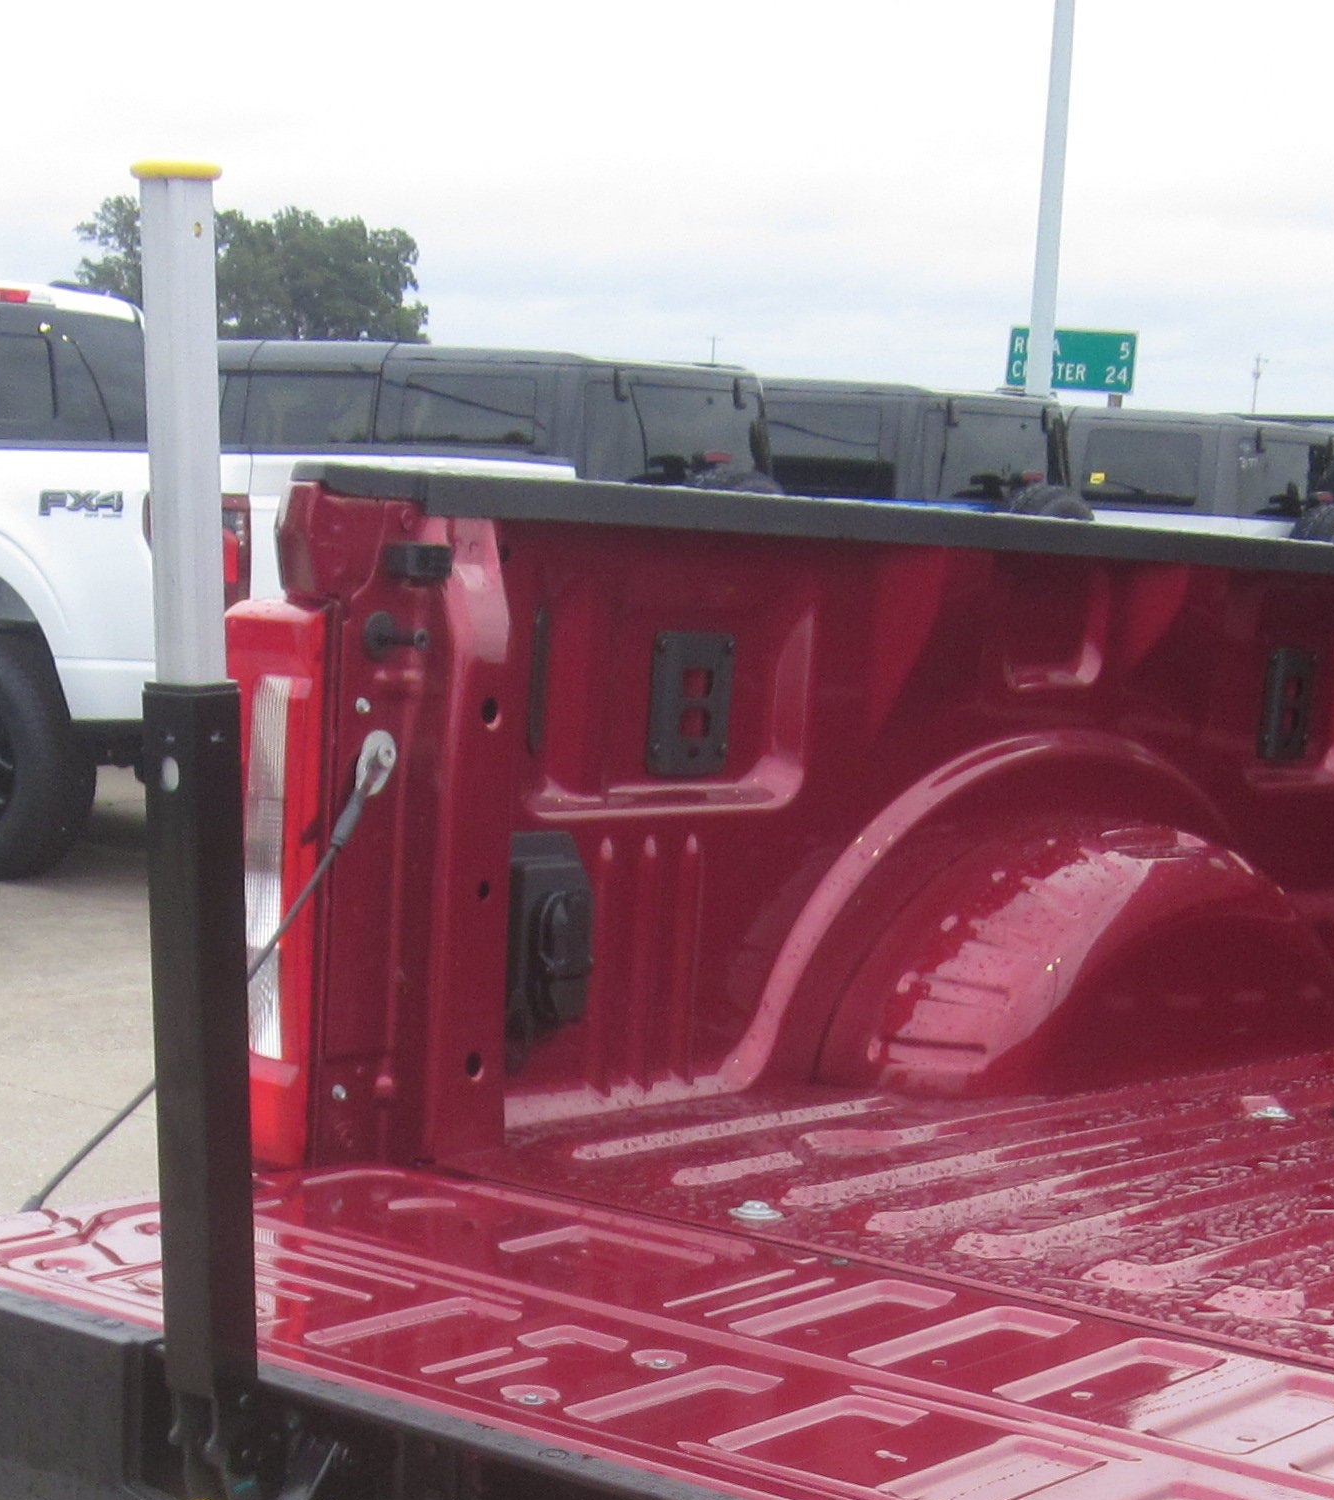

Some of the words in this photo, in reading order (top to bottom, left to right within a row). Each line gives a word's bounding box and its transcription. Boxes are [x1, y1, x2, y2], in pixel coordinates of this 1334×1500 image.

[1014, 337, 1060, 355] RA
[1119, 341, 1130, 360] 5
[1012, 360, 1086, 381] CTER
[1104, 366, 1128, 385] 24
[37, 488, 124, 516] FX4
